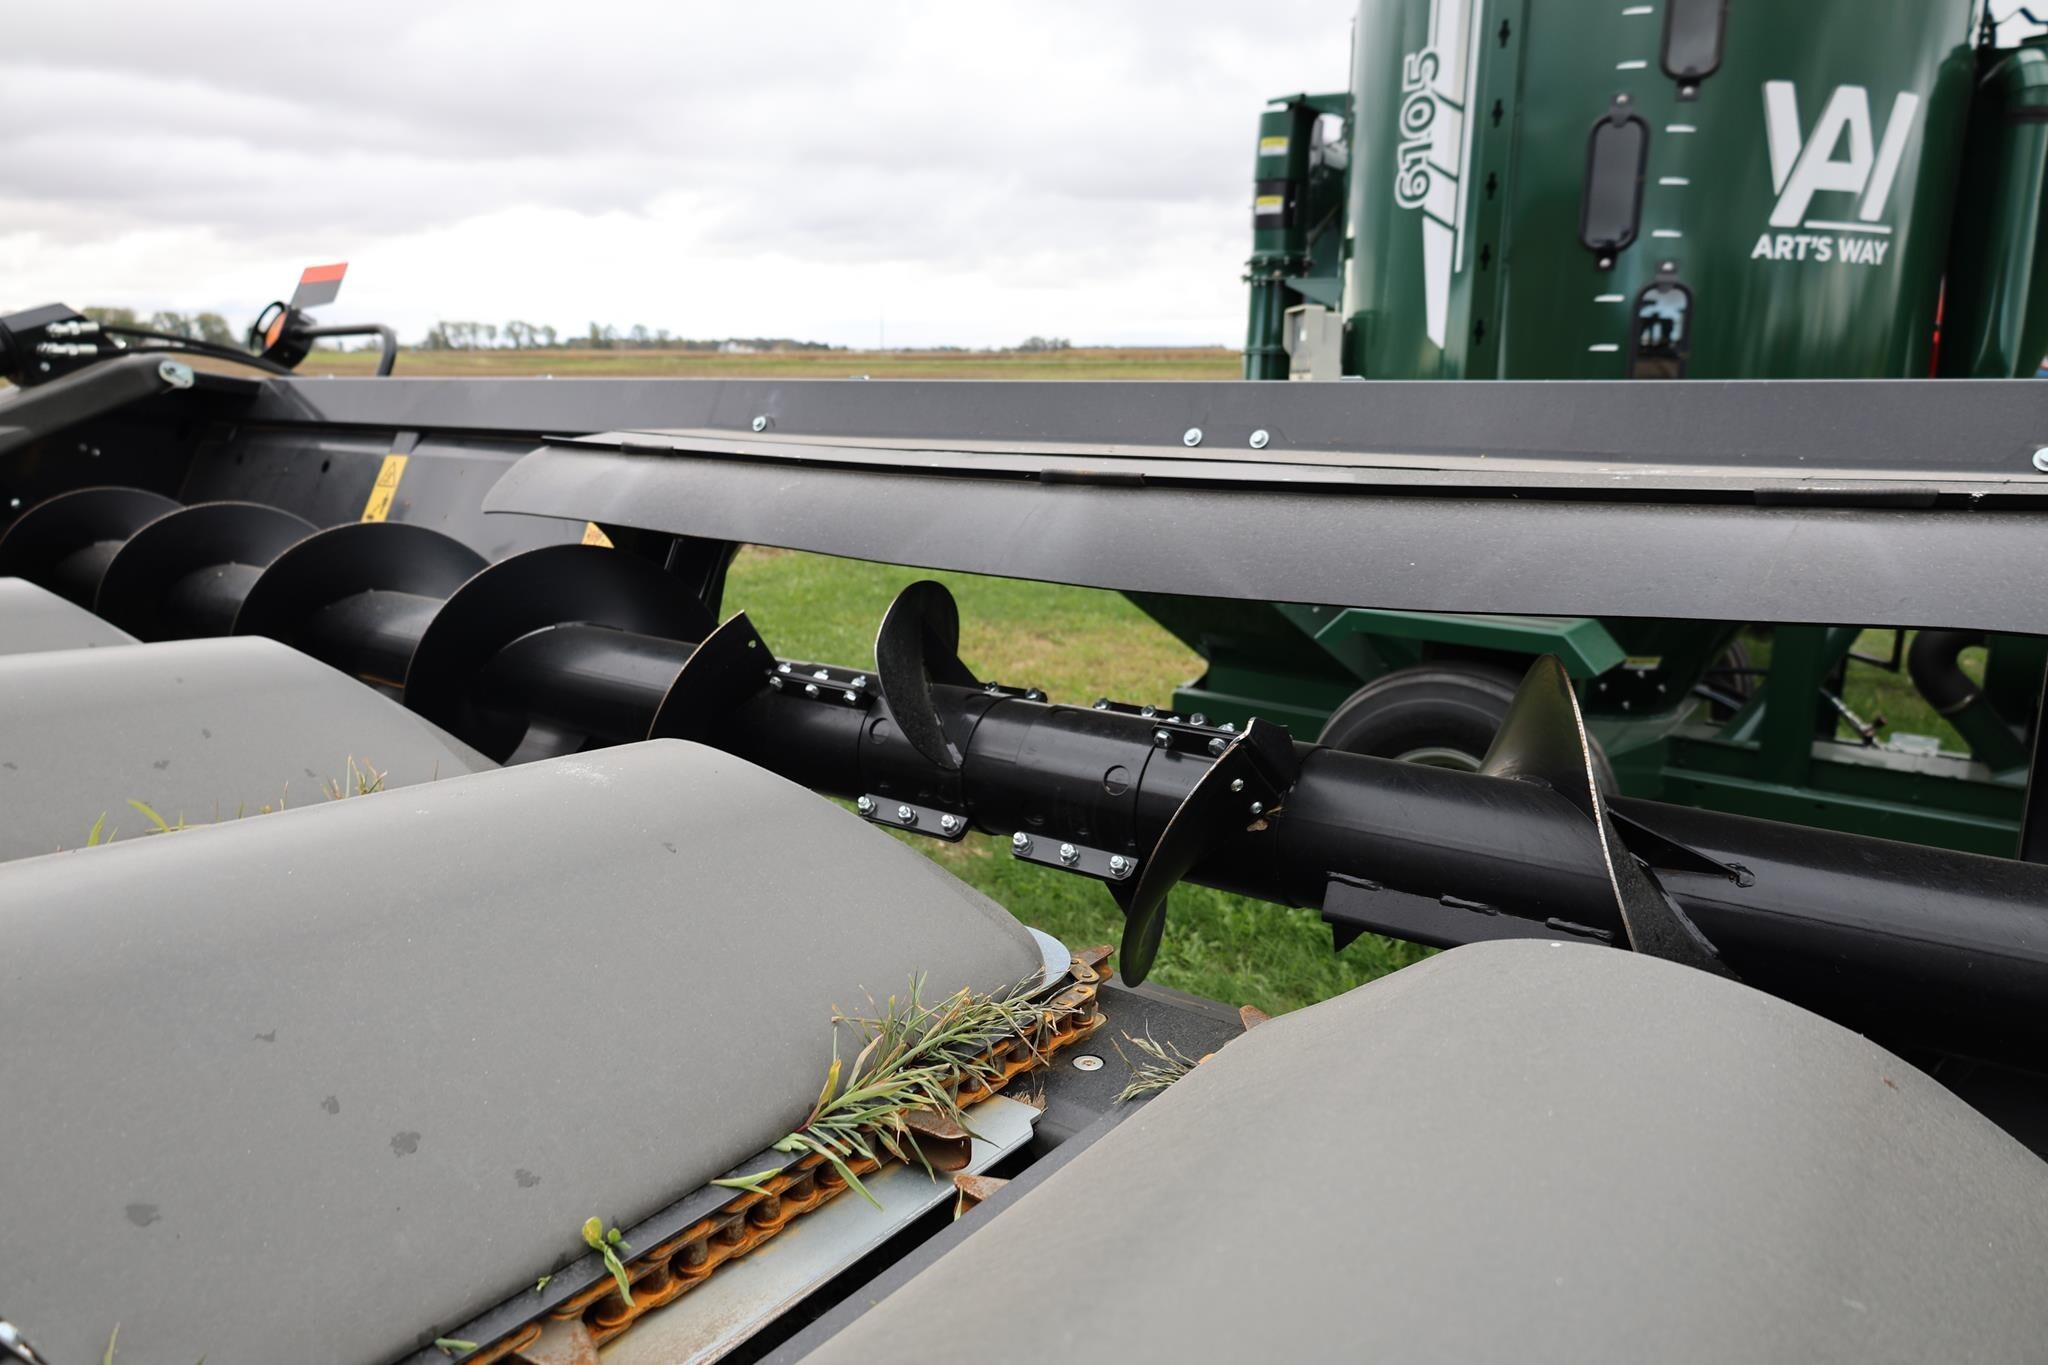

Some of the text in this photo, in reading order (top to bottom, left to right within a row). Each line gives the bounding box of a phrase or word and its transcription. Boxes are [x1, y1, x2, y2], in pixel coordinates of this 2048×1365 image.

[1394, 48, 1440, 209] 6105
[1751, 234, 1889, 265] ART'S WAY
